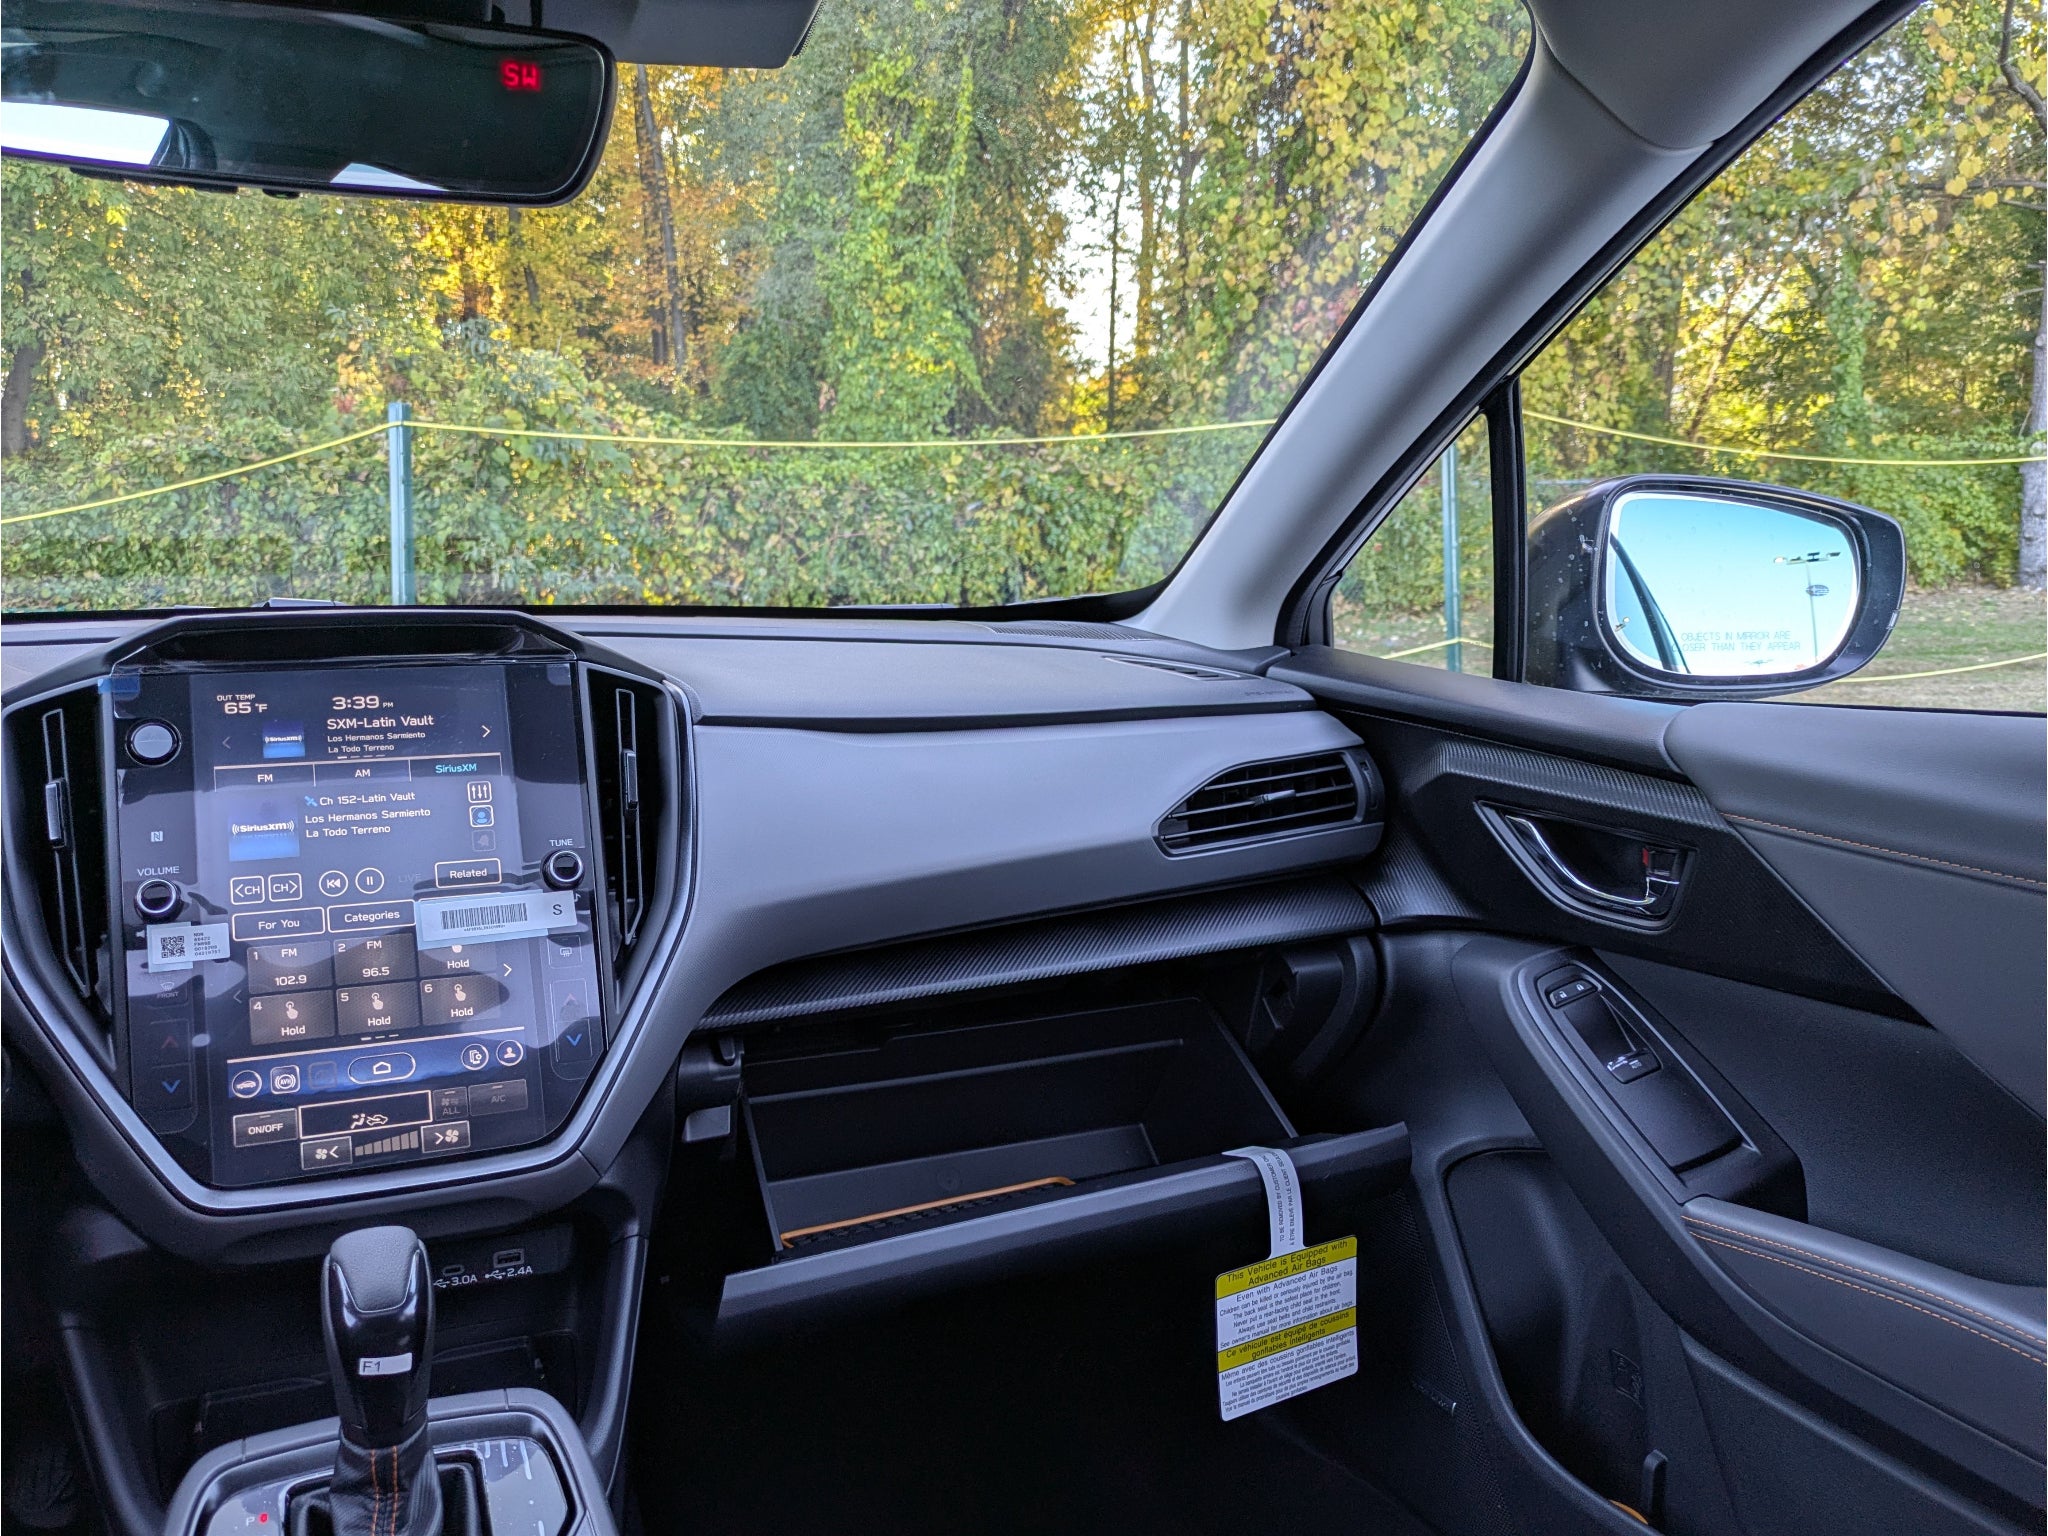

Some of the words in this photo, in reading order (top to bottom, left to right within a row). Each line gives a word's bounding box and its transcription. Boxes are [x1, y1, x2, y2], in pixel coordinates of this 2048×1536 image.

[502, 61, 539, 88] SW
[1680, 631, 1721, 641] OBJECTS
[1725, 631, 1733, 640] IN
[1736, 631, 1770, 640] MIRROR
[1774, 630, 1791, 640] ARE
[1711, 642, 1735, 652] THAN
[1740, 641, 1762, 651] THEY
[1767, 641, 1801, 651] APPEAR
[224, 702, 252, 715] 65
[332, 696, 380, 710] 3:39
[327, 716, 396, 730] SXM-Latin
[400, 714, 435, 727] Vault
[345, 733, 384, 742] Hermanos
[387, 732, 426, 740] Sarmiento
[341, 745, 360, 753] Todo
[363, 744, 394, 752] Terreno
[354, 768, 371, 778] AM
[435, 763, 478, 774] SiriusXM
[257, 774, 274, 784] FM
[319, 796, 334, 806] Ch
[338, 794, 386, 805] 152-Latin
[389, 792, 416, 802] Vault
[304, 814, 324, 824] Los
[328, 812, 378, 822] Hermanos
[381, 808, 432, 819] Sarmiento
[306, 829, 319, 838] La
[322, 828, 348, 838] Todo
[352, 825, 391, 836] Terreno
[549, 838, 574, 846] TUNE
[137, 866, 180, 876] VOLUME
[450, 868, 488, 878] Related
[244, 886, 260, 896] CH
[272, 883, 289, 893] CH
[552, 904, 562, 916] S
[344, 910, 400, 922] Categories
[258, 921, 276, 930] For
[281, 919, 300, 928] You
[338, 944, 346, 952] 2
[366, 940, 382, 950] FM
[254, 952, 259, 960] 1
[281, 948, 298, 958] FM
[447, 959, 470, 969] Hold
[362, 966, 390, 978] 96.5
[274, 974, 308, 986] 102.9
[424, 984, 433, 993] 6
[340, 992, 349, 1002] 5
[254, 1002, 262, 1011] 4
[450, 1007, 474, 1018] Hold
[368, 1016, 392, 1026] Hold
[281, 1026, 306, 1036] Hold
[443, 1106, 460, 1116] ALL
[248, 1123, 284, 1135] ON/OFF
[1227, 1271, 1243, 1281] This
[1247, 1261, 1276, 1274] Vehicle
[1280, 1257, 1286, 1265] is
[1290, 1245, 1327, 1263] Equipped
[1331, 1239, 1347, 1250] with
[506, 1266, 533, 1277] 2.4A
[1248, 1267, 1288, 1284] Advanced
[1291, 1262, 1302, 1272] Air
[1306, 1255, 1326, 1269] Bags
[451, 1274, 478, 1286] 3.0A
[1236, 1290, 1253, 1301] Even
[1256, 1285, 1270, 1295] with
[1273, 1274, 1306, 1289] Advanced
[1308, 1270, 1318, 1279] Air
[1321, 1264, 1337, 1276] Bags
[1226, 1348, 1236, 1357] Ce
[1270, 1333, 1280, 1342] est
[1308, 1321, 1317, 1329] de
[1320, 1312, 1348, 1324] coussins
[362, 1360, 380, 1373] F1
[246, 1516, 256, 1527] P
